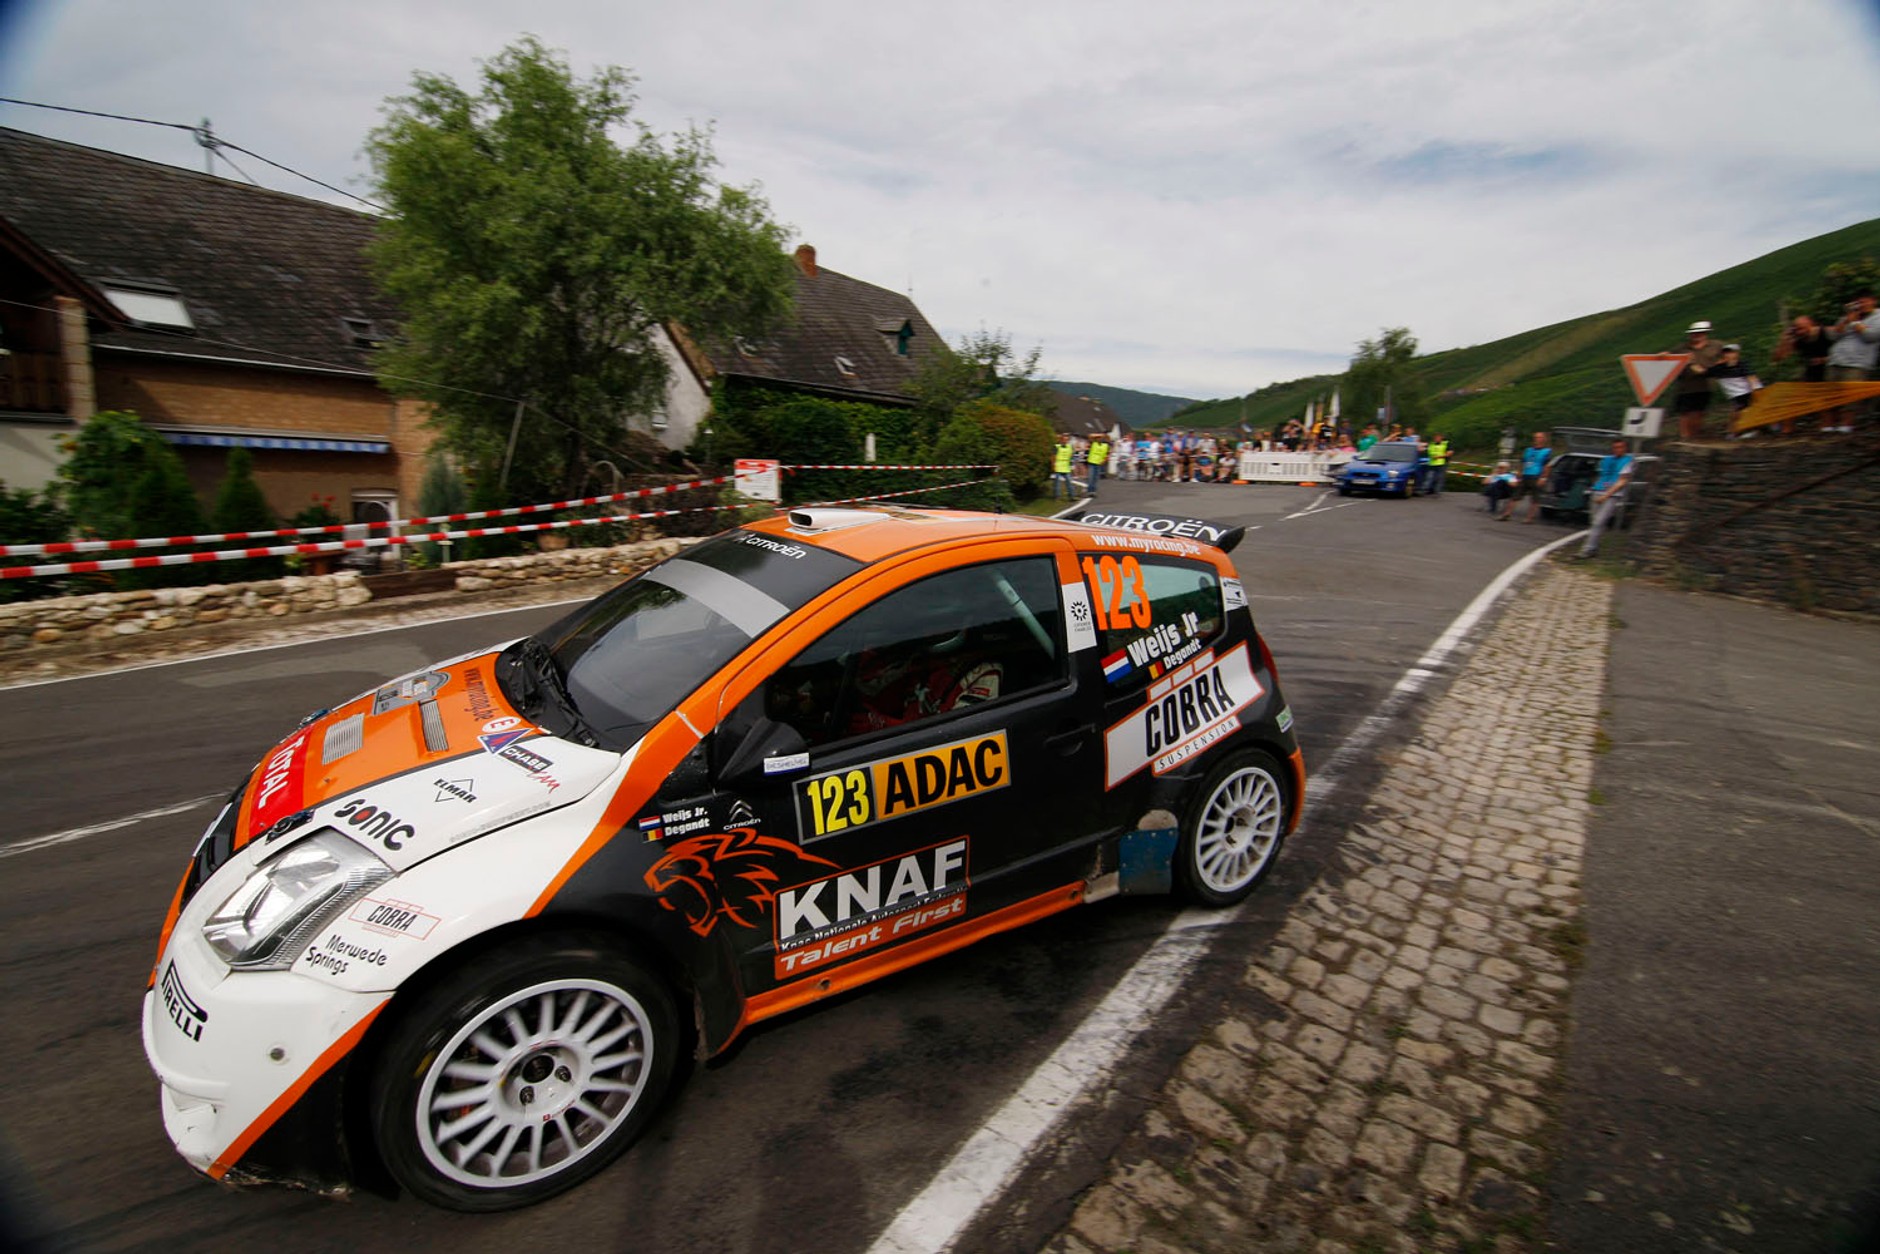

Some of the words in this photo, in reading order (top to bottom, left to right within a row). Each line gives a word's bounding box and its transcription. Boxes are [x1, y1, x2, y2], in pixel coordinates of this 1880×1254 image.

[1080, 514, 1230, 542] CITROËN
[746, 535, 807, 560] CITROËN
[1090, 534, 1201, 557] www.myracing.be
[1081, 555, 1151, 631] 123
[1127, 622, 1182, 668] Weijs
[1181, 611, 1200, 637] Jr
[1163, 638, 1202, 670] Degandt
[1144, 665, 1236, 758] COBRA
[503, 747, 548, 770] CHASE
[1157, 720, 1236, 770] SUSPENSION
[257, 735, 306, 810] TOTAL
[807, 769, 871, 838] 123
[884, 738, 1004, 816] ADAC
[433, 778, 478, 804] ELMAR
[662, 808, 693, 825] Weijs
[664, 817, 711, 837] Degandt
[780, 839, 967, 940] KNAF
[366, 904, 418, 931] COBRA
[325, 934, 388, 967] Merwede
[780, 926, 883, 972] Talent
[892, 897, 965, 935] First
[305, 945, 350, 976] Springs
[161, 957, 209, 1043] PIRELLI
